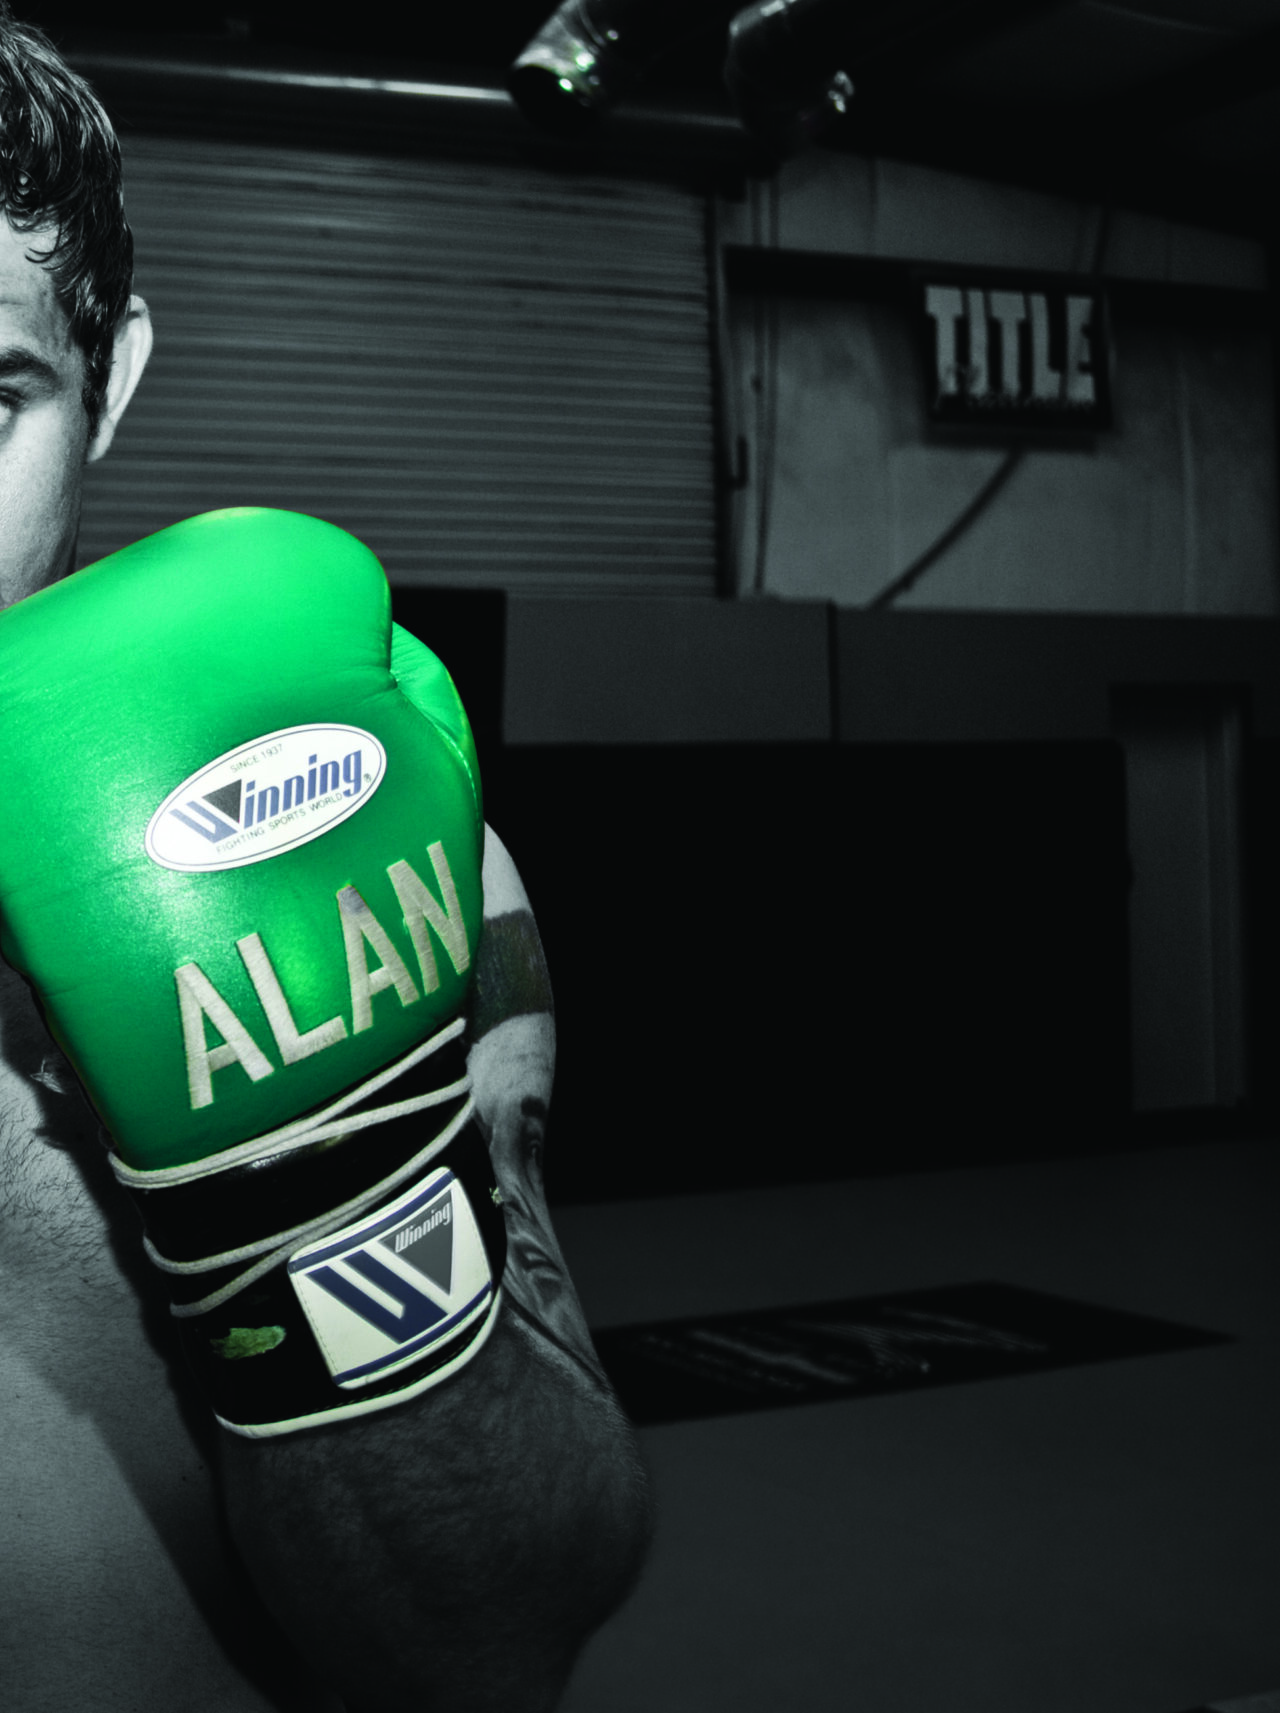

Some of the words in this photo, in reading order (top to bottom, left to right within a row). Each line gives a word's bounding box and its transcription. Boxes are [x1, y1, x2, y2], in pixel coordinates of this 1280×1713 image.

[924, 283, 1097, 406] TITLE
[169, 749, 363, 844] Winning
[229, 755, 260, 774] SINCE
[260, 742, 284, 762] 1937
[216, 828, 265, 854] FIGHTING
[268, 807, 307, 831] SPORTS
[310, 791, 343, 811] WORLD
[173, 840, 471, 1111] ALAN
[395, 1202, 451, 1254] Winning
